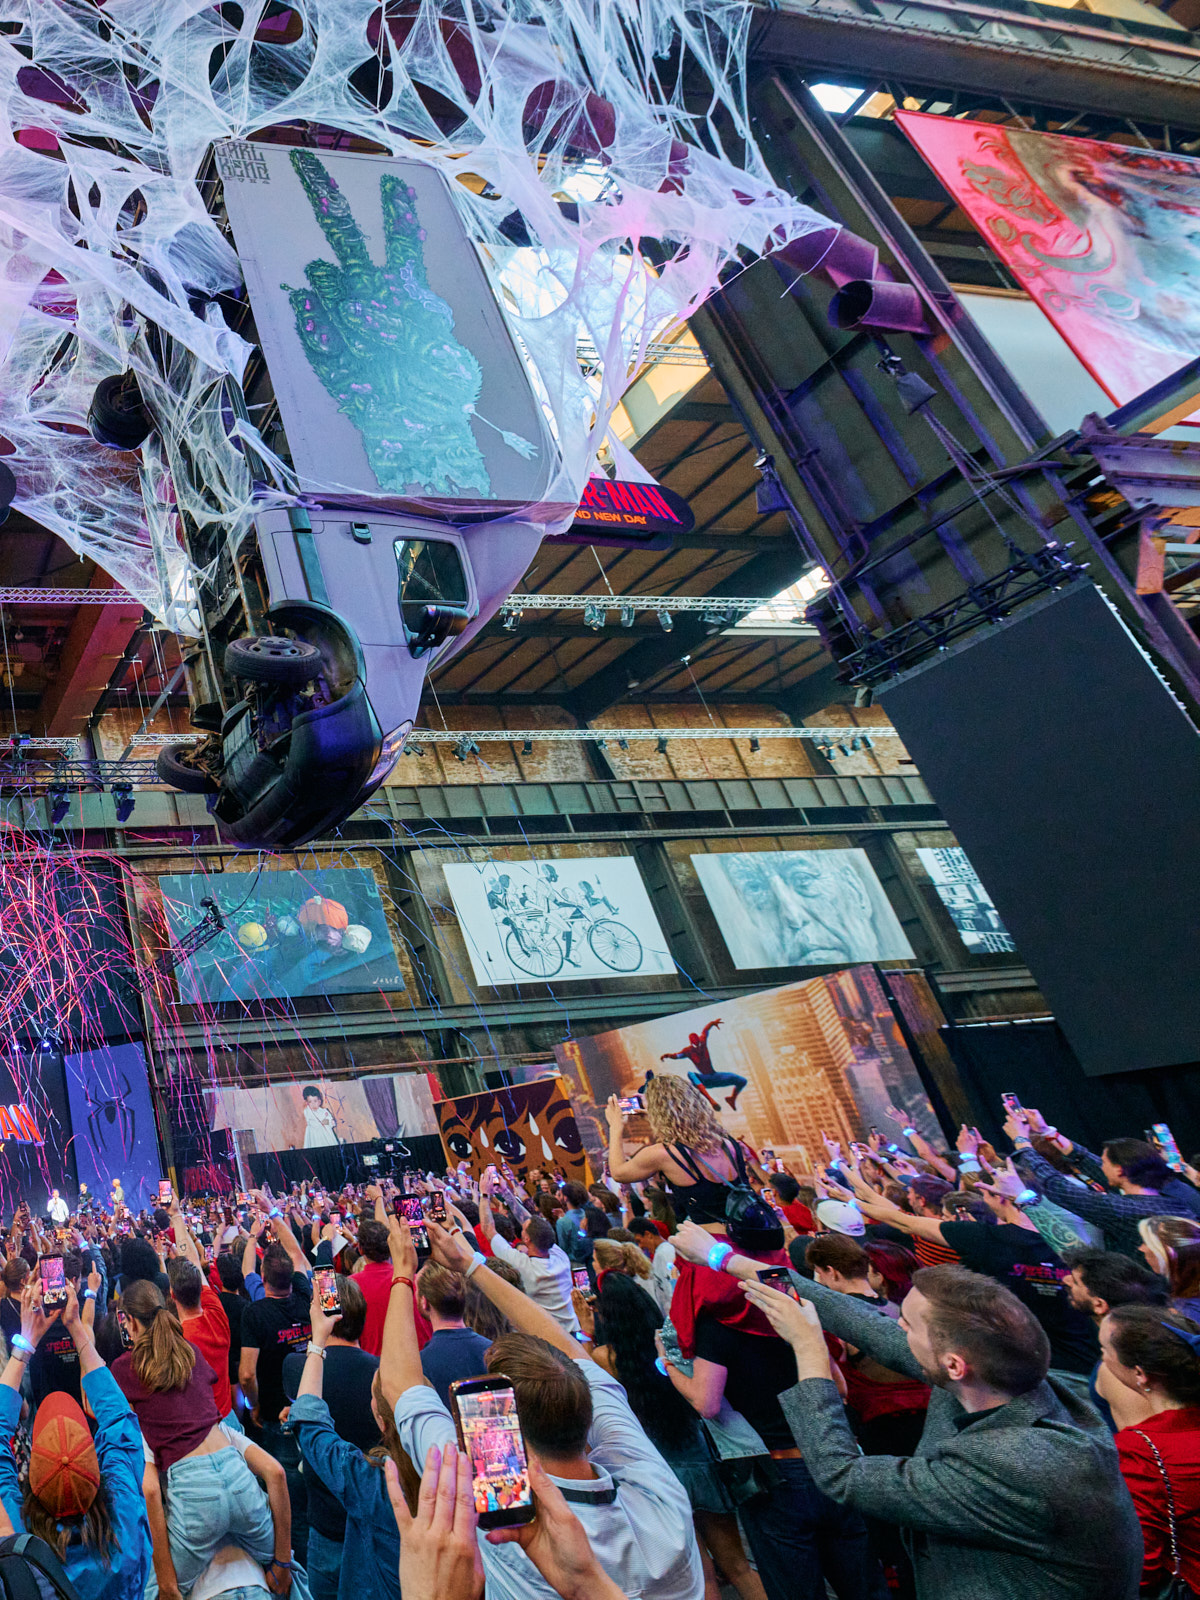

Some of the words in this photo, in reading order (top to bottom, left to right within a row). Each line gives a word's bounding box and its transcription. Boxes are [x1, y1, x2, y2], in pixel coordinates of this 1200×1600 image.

[580, 480, 681, 523] R-MAN
[595, 511, 622, 523] NEW
[623, 514, 647, 525] DAY
